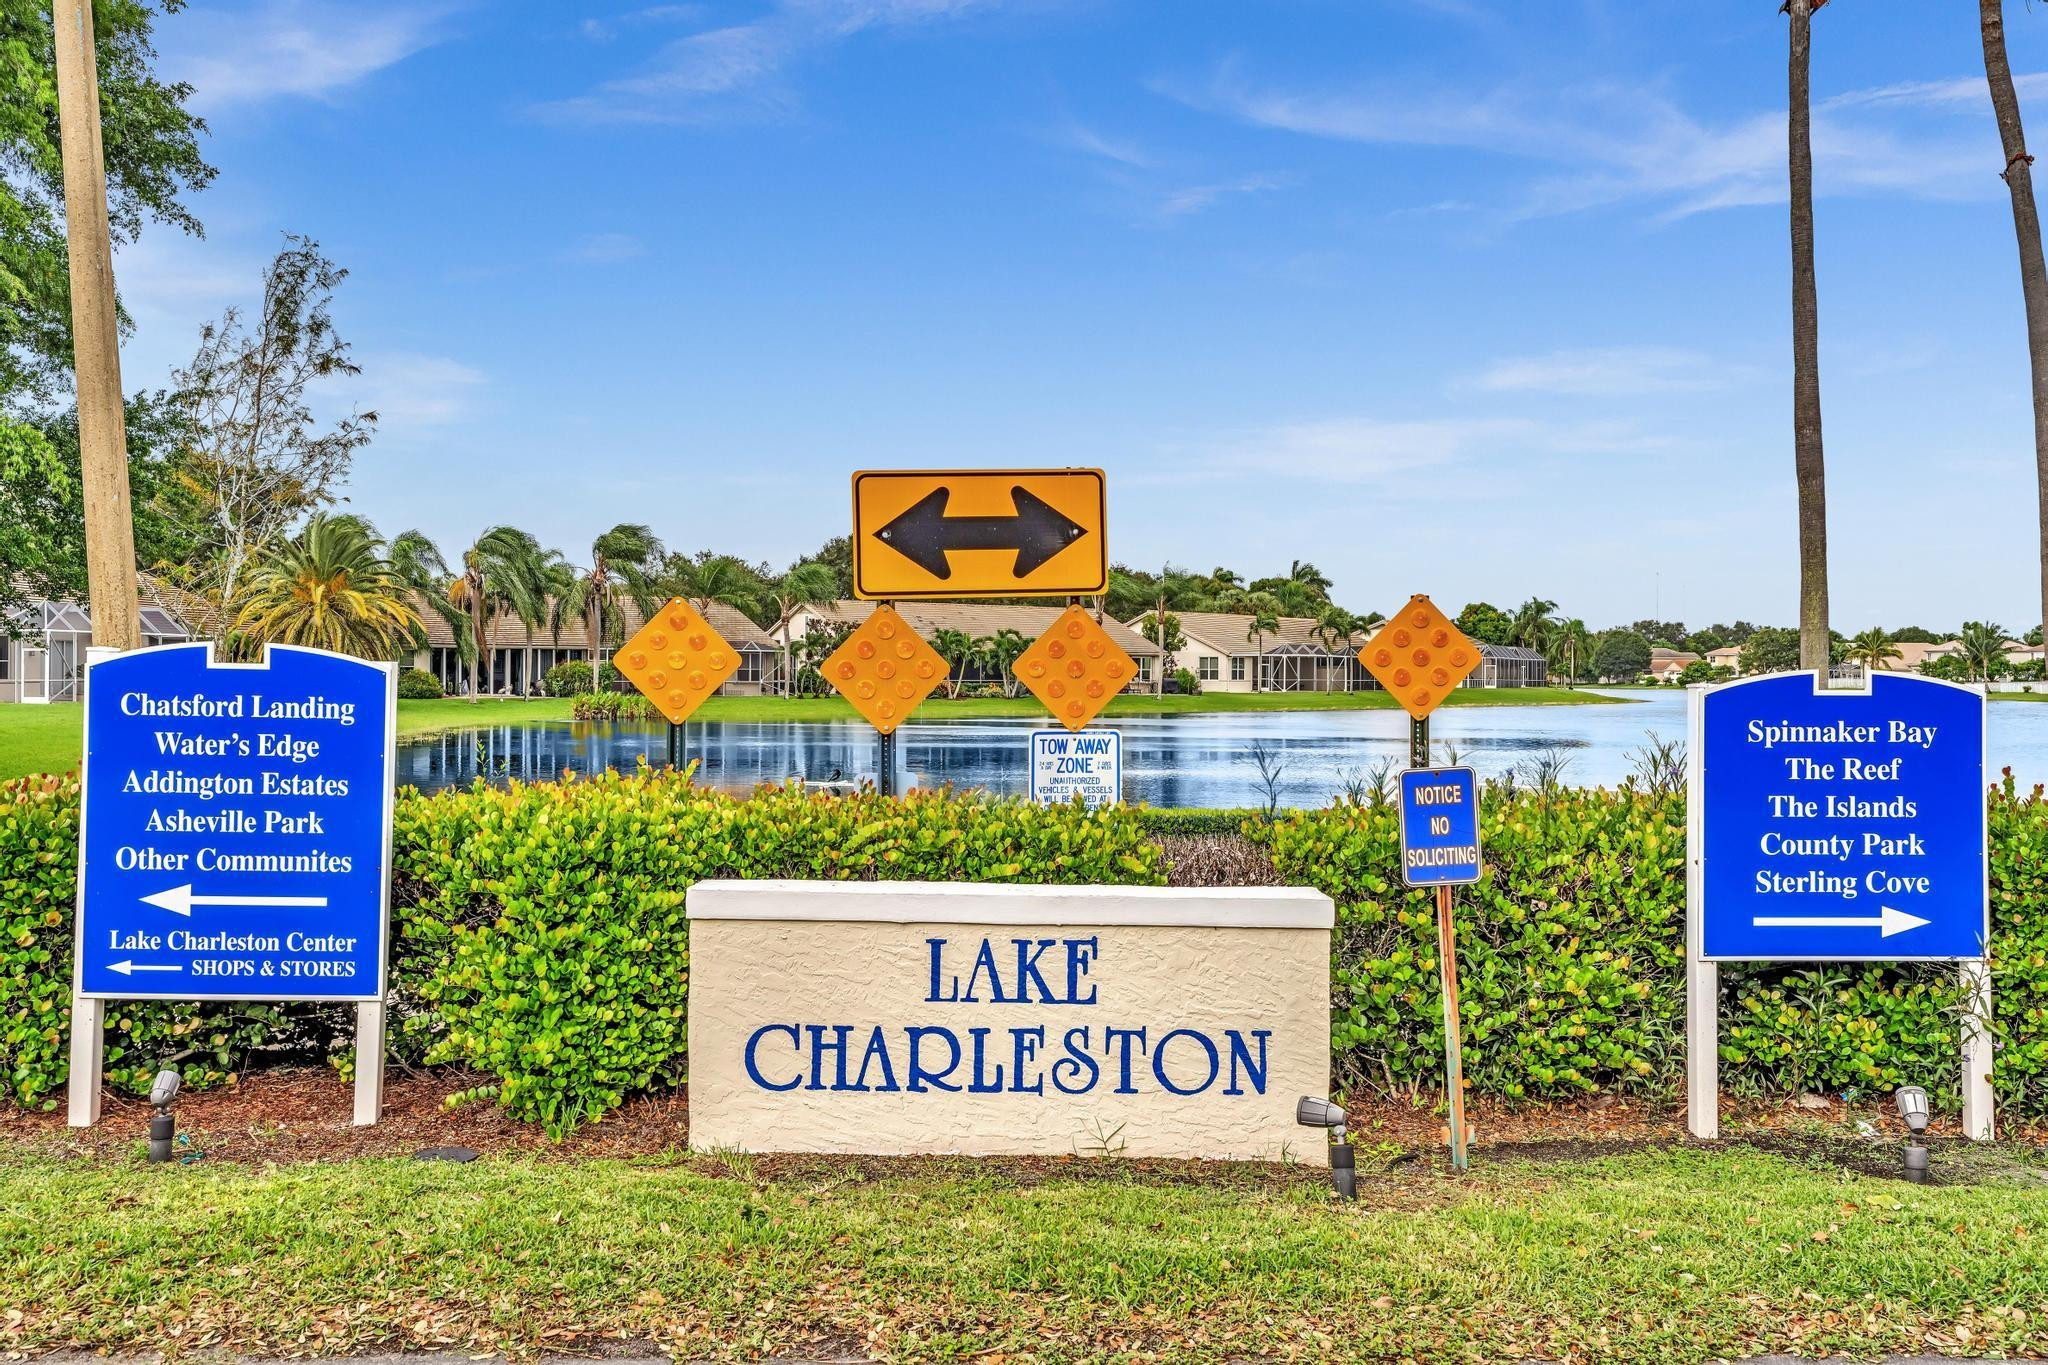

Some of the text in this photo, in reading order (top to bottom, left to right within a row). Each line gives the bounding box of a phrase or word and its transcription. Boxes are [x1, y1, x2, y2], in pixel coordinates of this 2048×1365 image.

[120, 692, 356, 726] Chatsford Landing
[1747, 719, 1938, 749] Spinnaker Bay
[154, 731, 320, 763] Water's Edge
[1039, 738, 1112, 755] TOW AWAY
[1056, 757, 1094, 774] ZONE
[1784, 757, 1903, 781] The Reef
[122, 769, 349, 800] Addington Estates
[1038, 786, 1070, 794] VEHICLES
[1082, 785, 1113, 794] VESSELS
[1049, 776, 1101, 785] UNAUTHORIZED
[1043, 795, 1059, 803] WILL
[1061, 794, 1071, 803] BE
[1415, 785, 1462, 805] NOTICE
[1768, 795, 1917, 818] The Islands
[145, 808, 324, 834] Asheville Park
[1431, 816, 1450, 836] NO
[1407, 846, 1477, 868] SOLICITING
[1760, 832, 1926, 861] County Park
[115, 846, 352, 873] Other Communites
[1755, 870, 1930, 899] Sterling Cove
[109, 929, 357, 952] Lake Charleston Center
[191, 959, 356, 978] SHOPS & STORES
[925, 936, 1099, 1005] LAKE
[744, 1024, 1272, 1097] CHARLESTON
